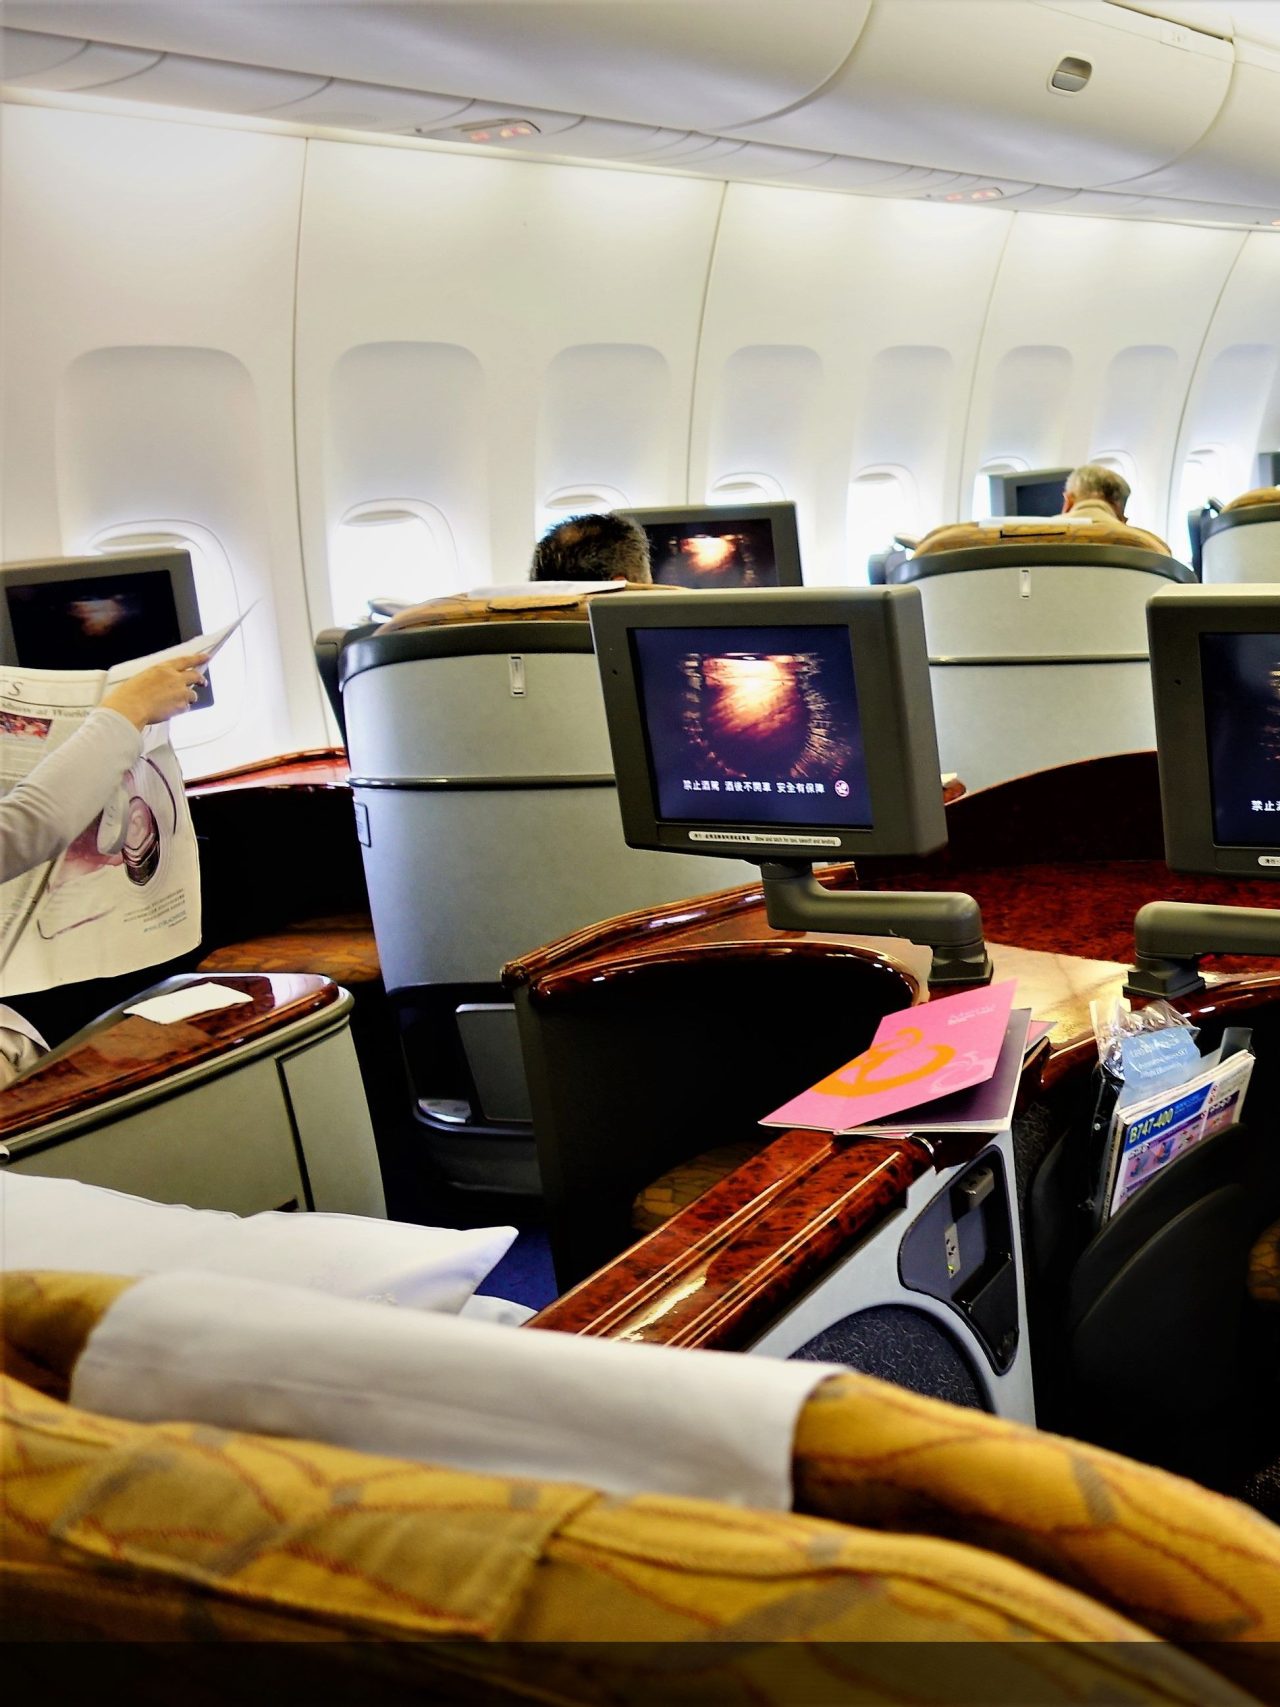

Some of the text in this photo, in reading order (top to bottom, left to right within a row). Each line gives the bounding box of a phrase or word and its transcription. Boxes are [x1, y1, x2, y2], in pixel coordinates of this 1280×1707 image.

[683, 780, 825, 794] 禁止酒駕 酒後不開車 安全有保障
[1129, 1107, 1174, 1144] B747-400
